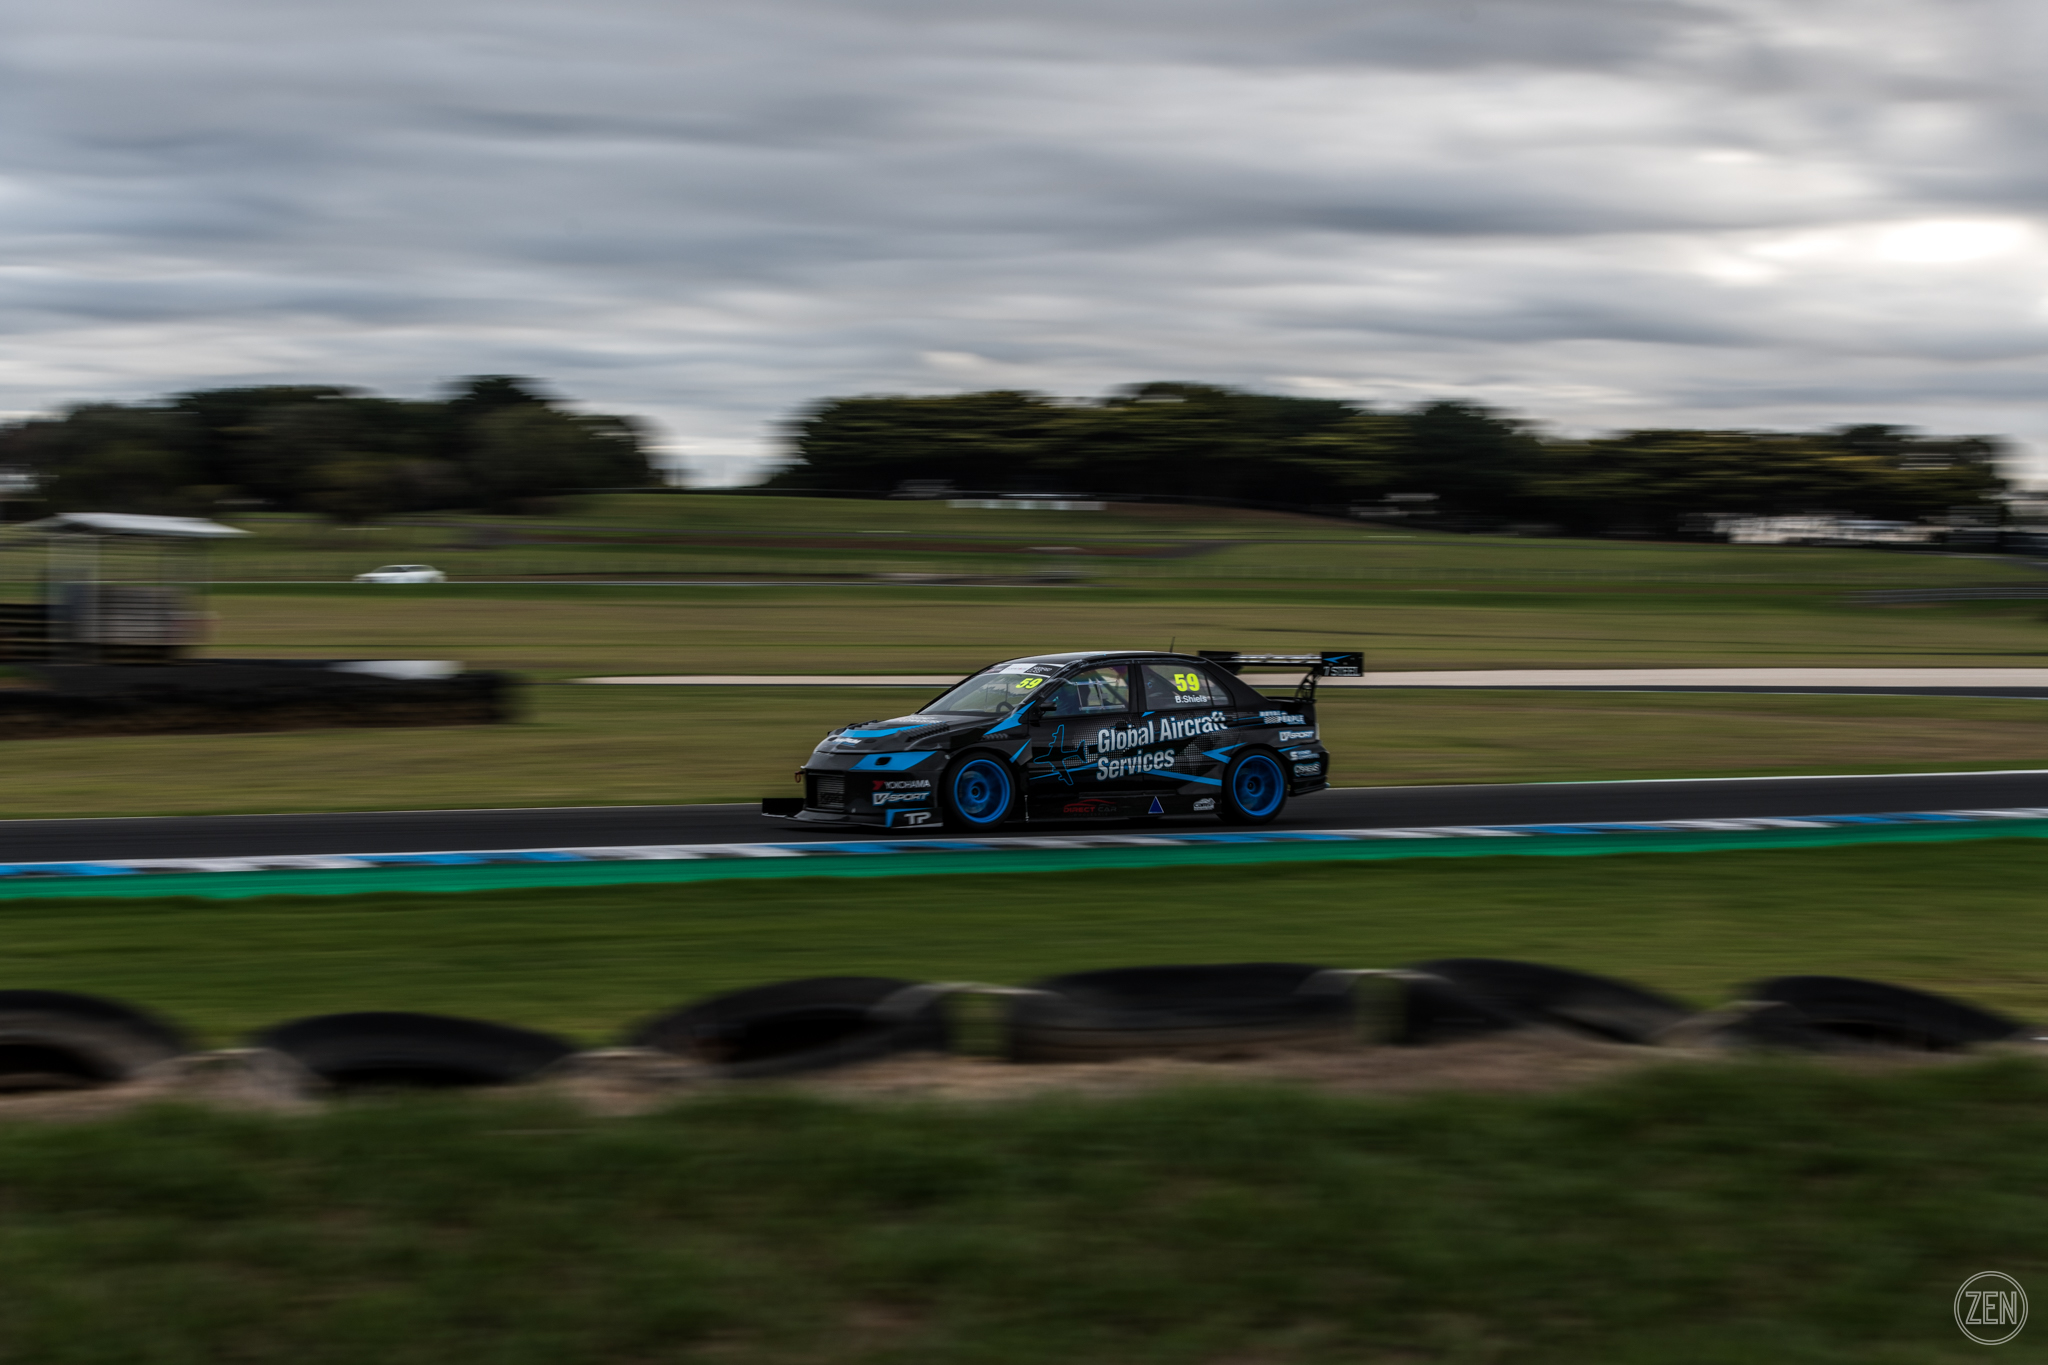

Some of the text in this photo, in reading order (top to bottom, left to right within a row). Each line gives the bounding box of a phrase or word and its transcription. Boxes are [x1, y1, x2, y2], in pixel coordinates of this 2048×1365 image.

[1015, 677, 1043, 689] 59
[1173, 672, 1201, 692] 59
[1097, 710, 1229, 754] Global Aircraft
[1096, 749, 1175, 781] Services
[884, 780, 931, 789] YOKOHAMA
[873, 792, 930, 805] V-SPORT
